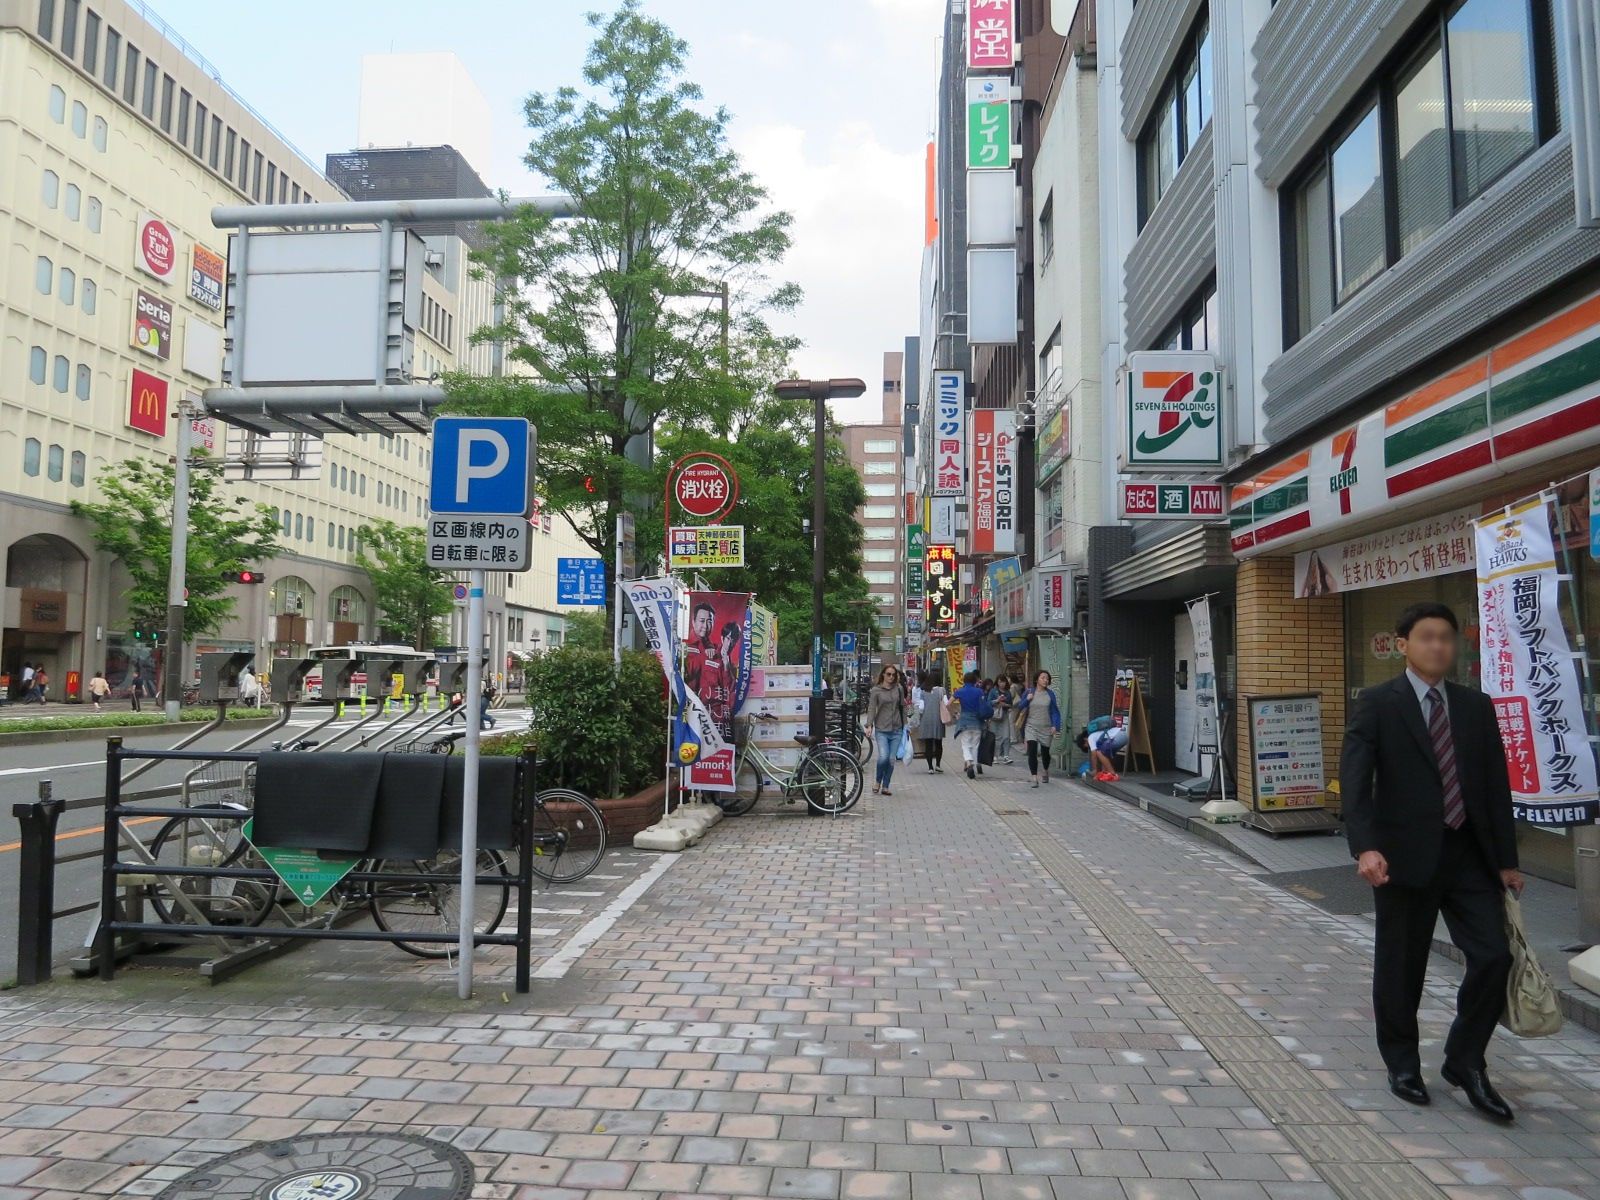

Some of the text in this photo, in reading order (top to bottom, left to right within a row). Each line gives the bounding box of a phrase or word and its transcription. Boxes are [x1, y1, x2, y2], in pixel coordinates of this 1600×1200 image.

[979, 107, 999, 163] レイク
[138, 295, 171, 324] Seria
[1172, 402, 1215, 411] HOLDINGS
[938, 375, 961, 489] コミック同人誌
[456, 428, 510, 503] P
[681, 479, 724, 499] 消火栓
[977, 432, 992, 530] ジーストア福岡
[1126, 489, 1155, 510] たばこ
[1164, 489, 1183, 510] 酒
[1193, 490, 1220, 509] ATM
[432, 521, 520, 539] 区画線内の
[675, 531, 696, 542] 買取
[431, 544, 519, 562] 自転車に限る
[675, 544, 697, 555] 販売
[698, 540, 740, 556] 真子質店
[929, 548, 953, 560] 本格
[1489, 547, 1528, 570] HAWKS
[704, 556, 740, 564] 721-0777
[1342, 537, 1474, 586] 生まれ変わって新登場!
[929, 561, 953, 619] 回転すし
[1053, 576, 1061, 607] シャチハタ
[840, 633, 852, 650] P
[1511, 574, 1579, 794] 福岡ソフトバンクホークス
[1274, 703, 1312, 713] 福岡銀行
[1507, 701, 1533, 790] 観戦チケット
